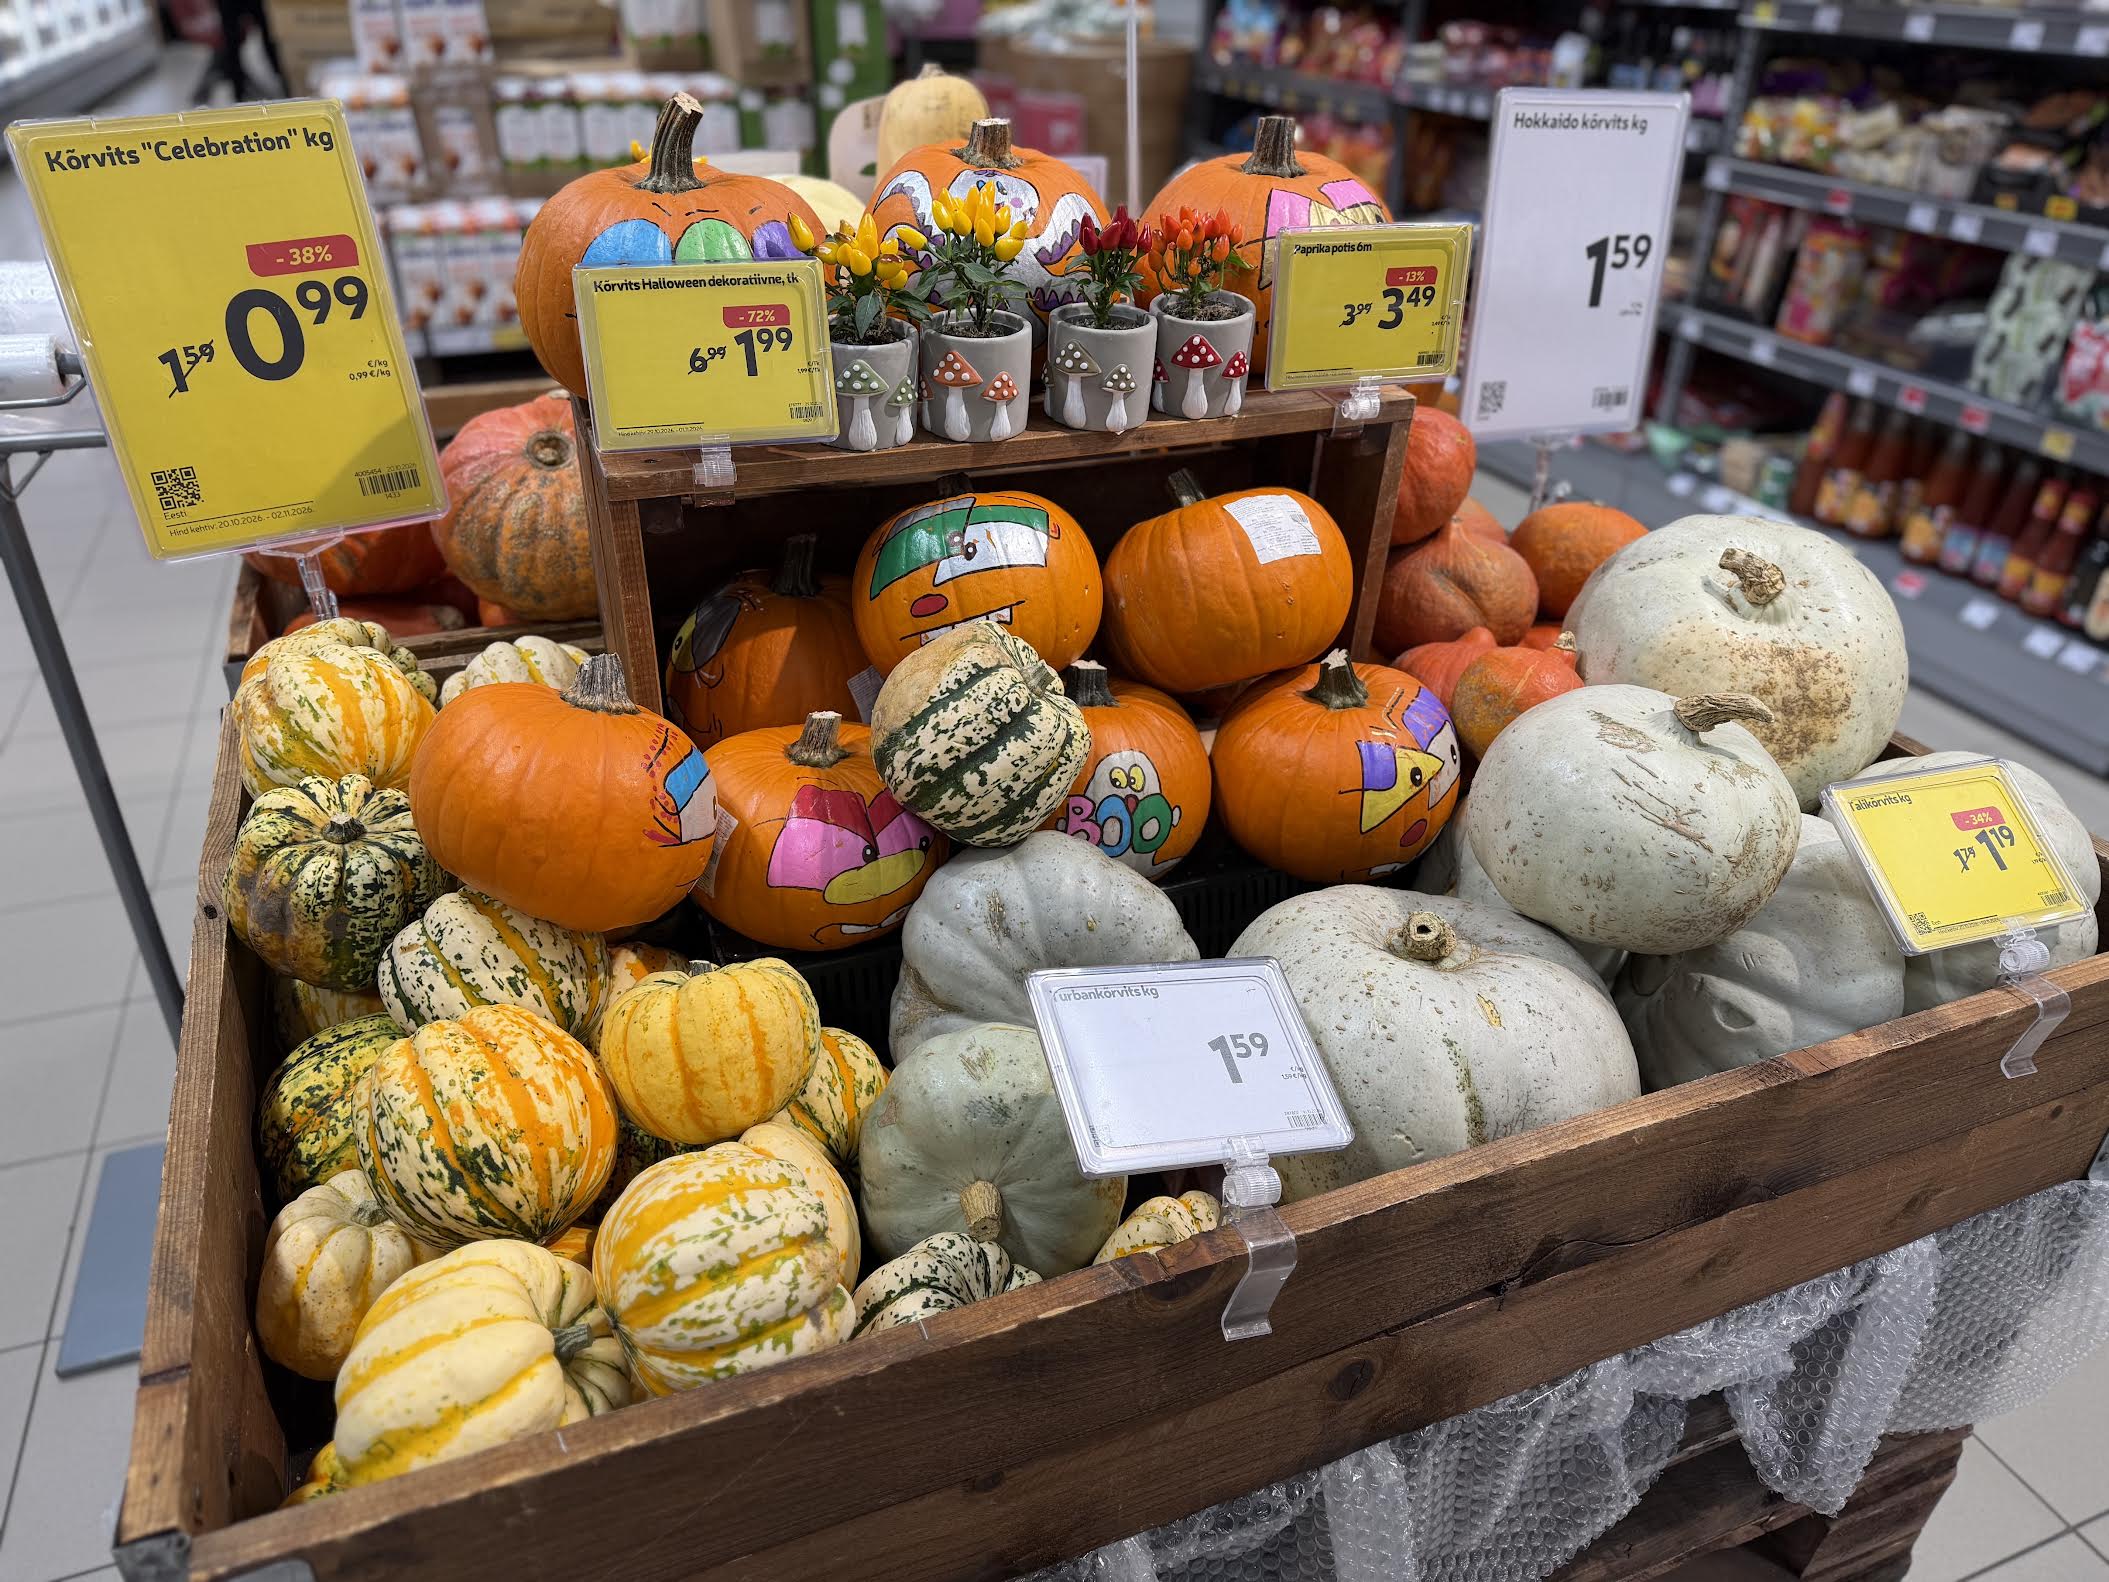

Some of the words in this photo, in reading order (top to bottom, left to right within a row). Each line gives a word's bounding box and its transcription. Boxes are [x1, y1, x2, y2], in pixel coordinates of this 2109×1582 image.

[1513, 112, 1580, 130] Hokkaido
[1631, 115, 1648, 135] kg
[45, 146, 140, 172] Kõrvits
[142, 128, 298, 161] "Celebration"
[303, 127, 334, 151] kg
[289, 245, 332, 266] 38%
[1293, 244, 1330, 257] Paprika
[1332, 242, 1356, 256] potis
[1357, 242, 1373, 252] 6m
[593, 279, 641, 292] Kõrvits
[641, 277, 707, 290] Halloween
[708, 273, 785, 287] dekoratiivne,
[786, 272, 799, 284] tk
[1406, 271, 1425, 282] 13%
[748, 310, 775, 322] 72%
[367, 359, 388, 369] €/kg
[164, 510, 188, 521] Eesti
[170, 525, 190, 537] Hind
[1896, 791, 1913, 804] kg
[1970, 812, 1993, 824] 34%
[1066, 793, 1174, 857] BOO
[1140, 985, 1159, 999] kg
